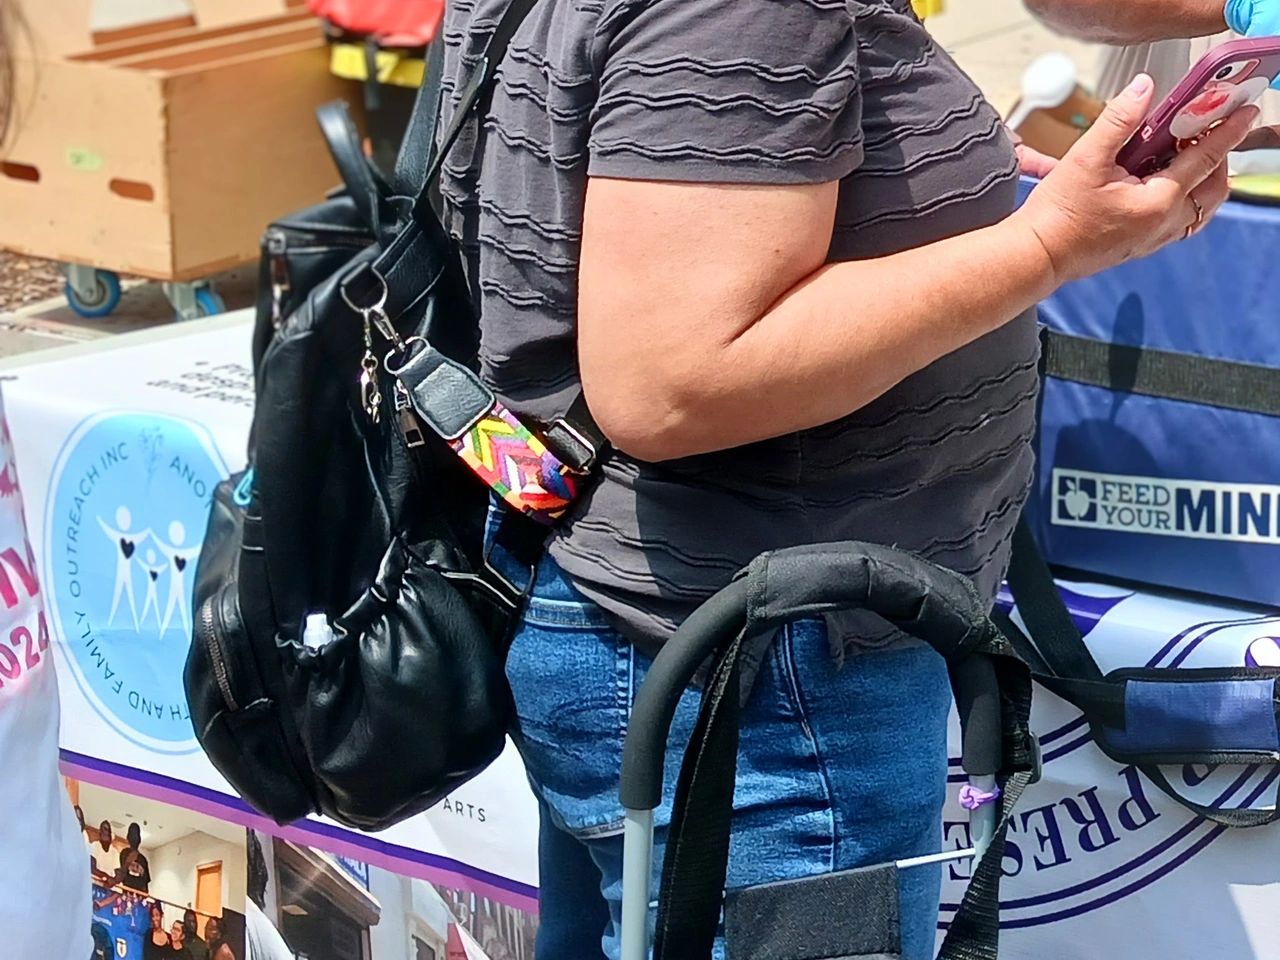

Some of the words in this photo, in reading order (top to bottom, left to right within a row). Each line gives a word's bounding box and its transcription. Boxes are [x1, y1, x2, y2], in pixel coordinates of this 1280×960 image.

[169, 455, 213, 509] ANO
[1101, 480, 1171, 506] FEED
[66, 463, 101, 598] OUTREACH
[101, 442, 129, 471] INC
[1101, 503, 1171, 530] YOUR
[0, 611, 49, 688] 024
[74, 610, 123, 695] FAMILY
[129, 691, 164, 720] AND
[443, 797, 487, 823] ARTS
